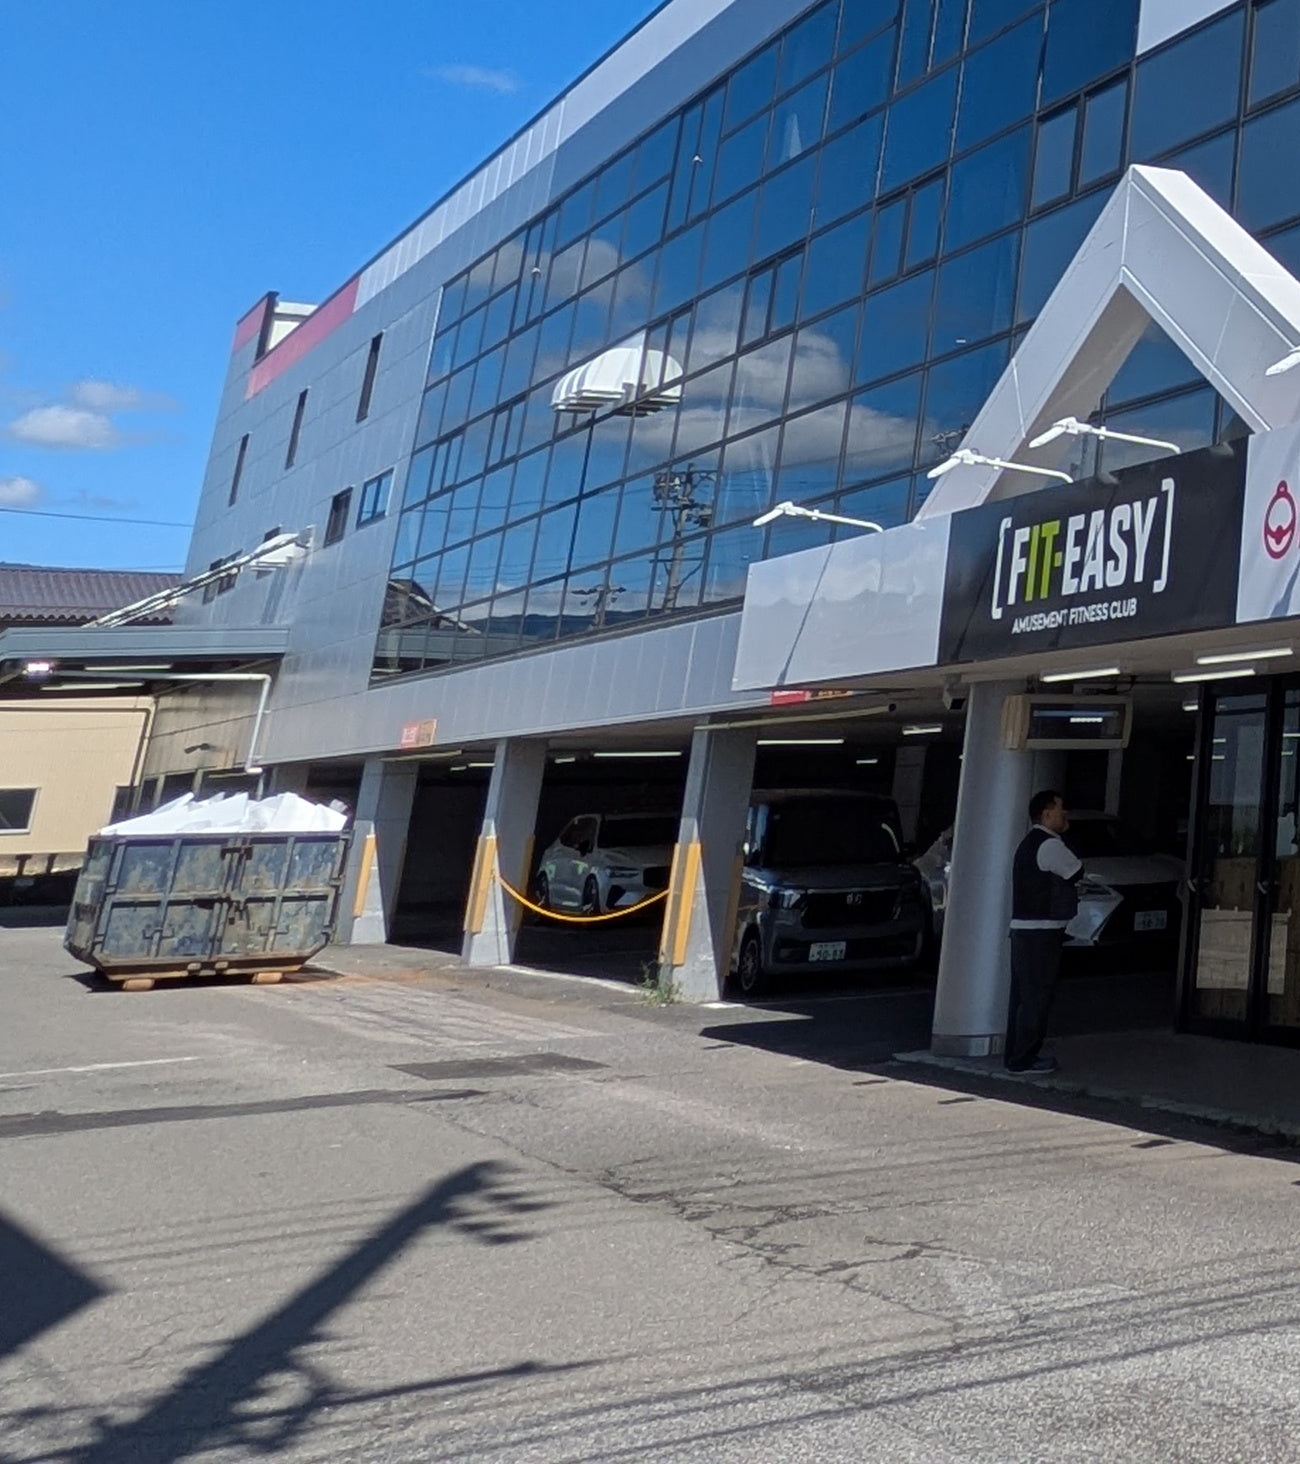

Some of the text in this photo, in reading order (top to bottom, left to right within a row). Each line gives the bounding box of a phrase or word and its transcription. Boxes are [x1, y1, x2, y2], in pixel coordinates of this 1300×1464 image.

[1012, 598, 1138, 635] AMUSEMENT FITNESS CLUB
